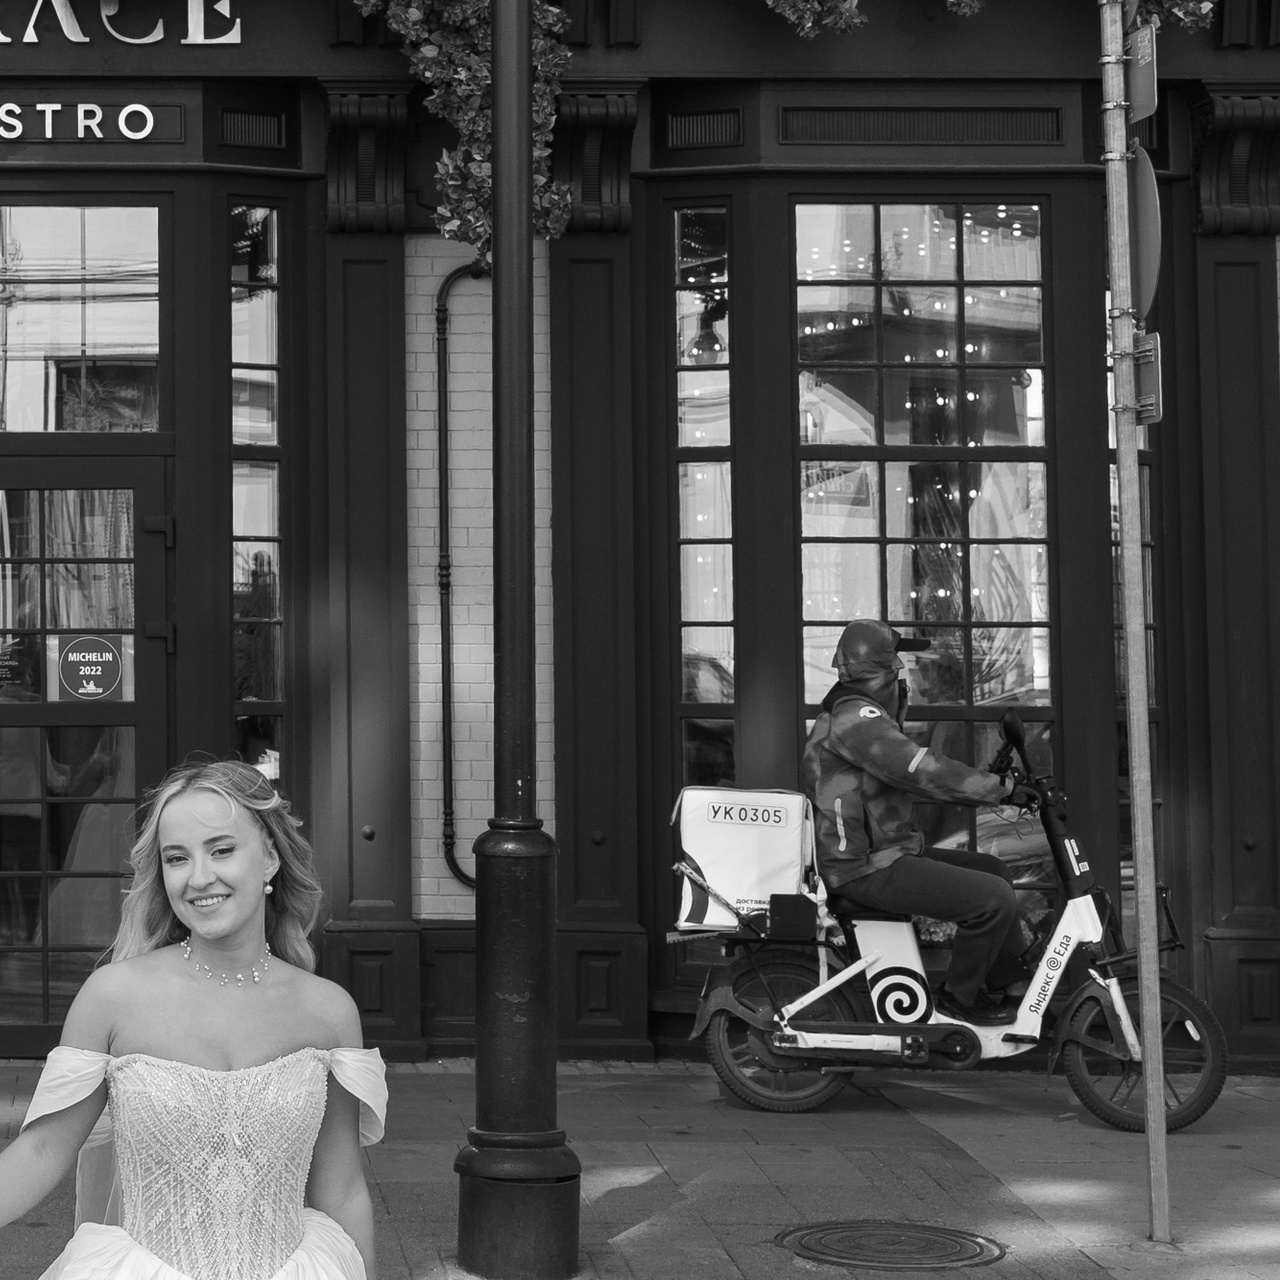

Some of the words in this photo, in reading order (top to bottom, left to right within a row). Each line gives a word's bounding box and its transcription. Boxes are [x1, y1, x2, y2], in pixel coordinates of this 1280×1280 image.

[68, 652, 113, 662] MICHELIN
[79, 665, 102, 675] 2022
[1028, 972, 1055, 1015] Яндекс
[1053, 934, 1072, 957] Еда
